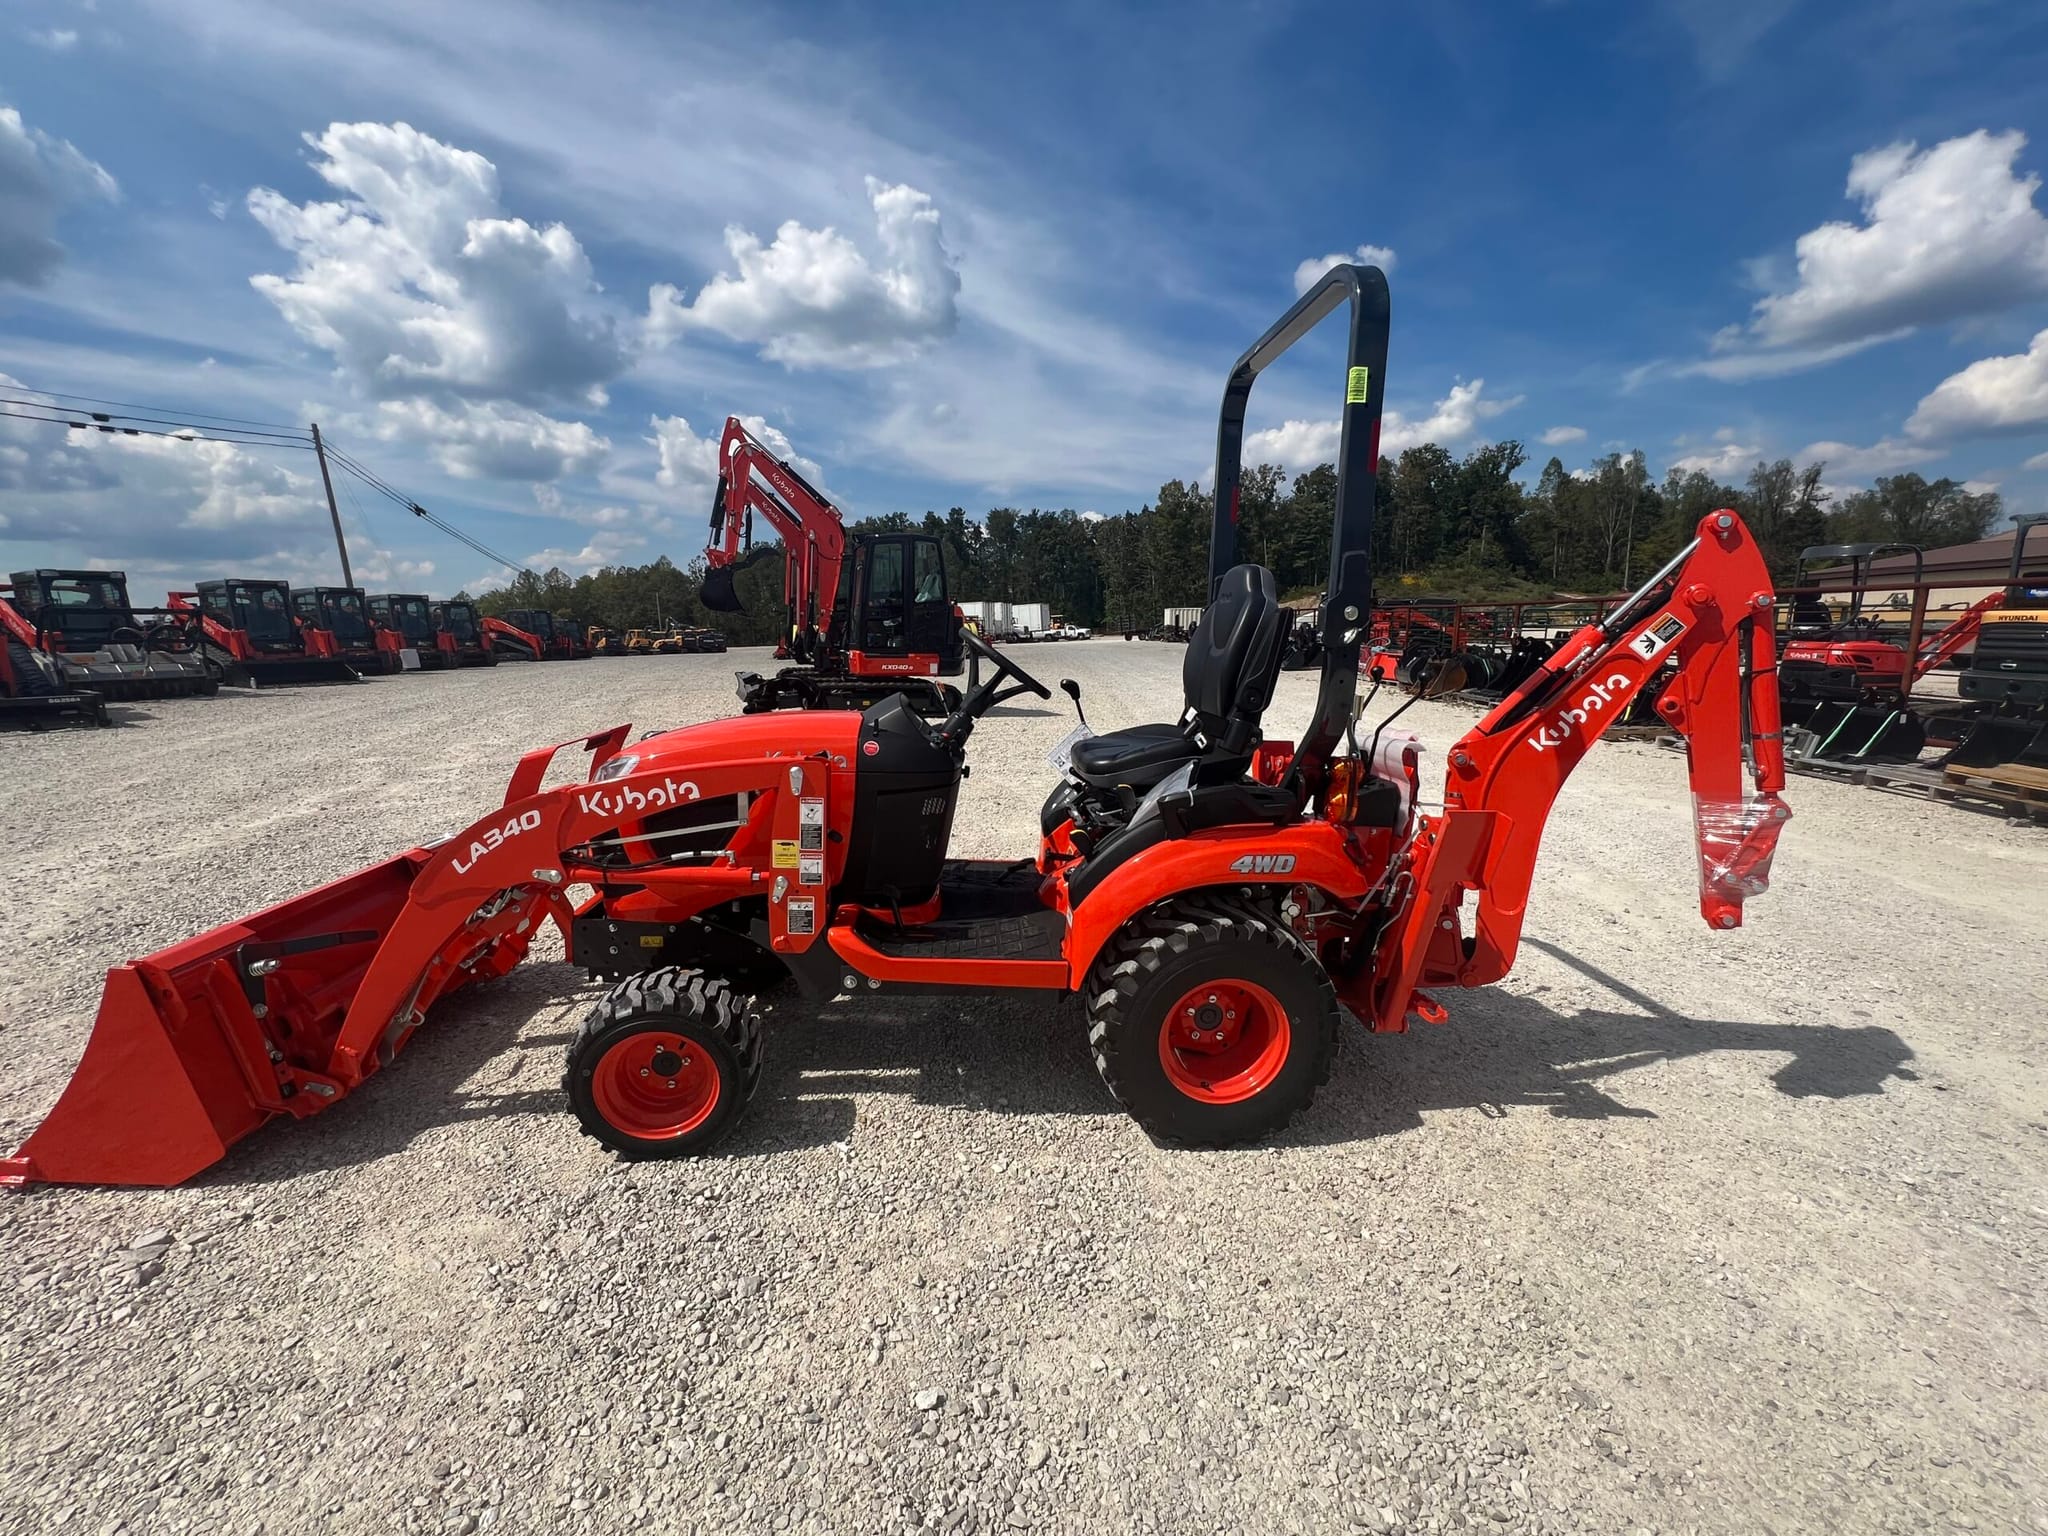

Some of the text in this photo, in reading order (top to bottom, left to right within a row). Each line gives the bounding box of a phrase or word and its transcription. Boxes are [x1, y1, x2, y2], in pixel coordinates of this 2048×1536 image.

[772, 473, 795, 498] Kubota
[1527, 673, 1632, 752] Kubota
[579, 777, 701, 817] Kubota
[450, 809, 541, 875] LA340
[1230, 854, 1296, 874] 4WD
